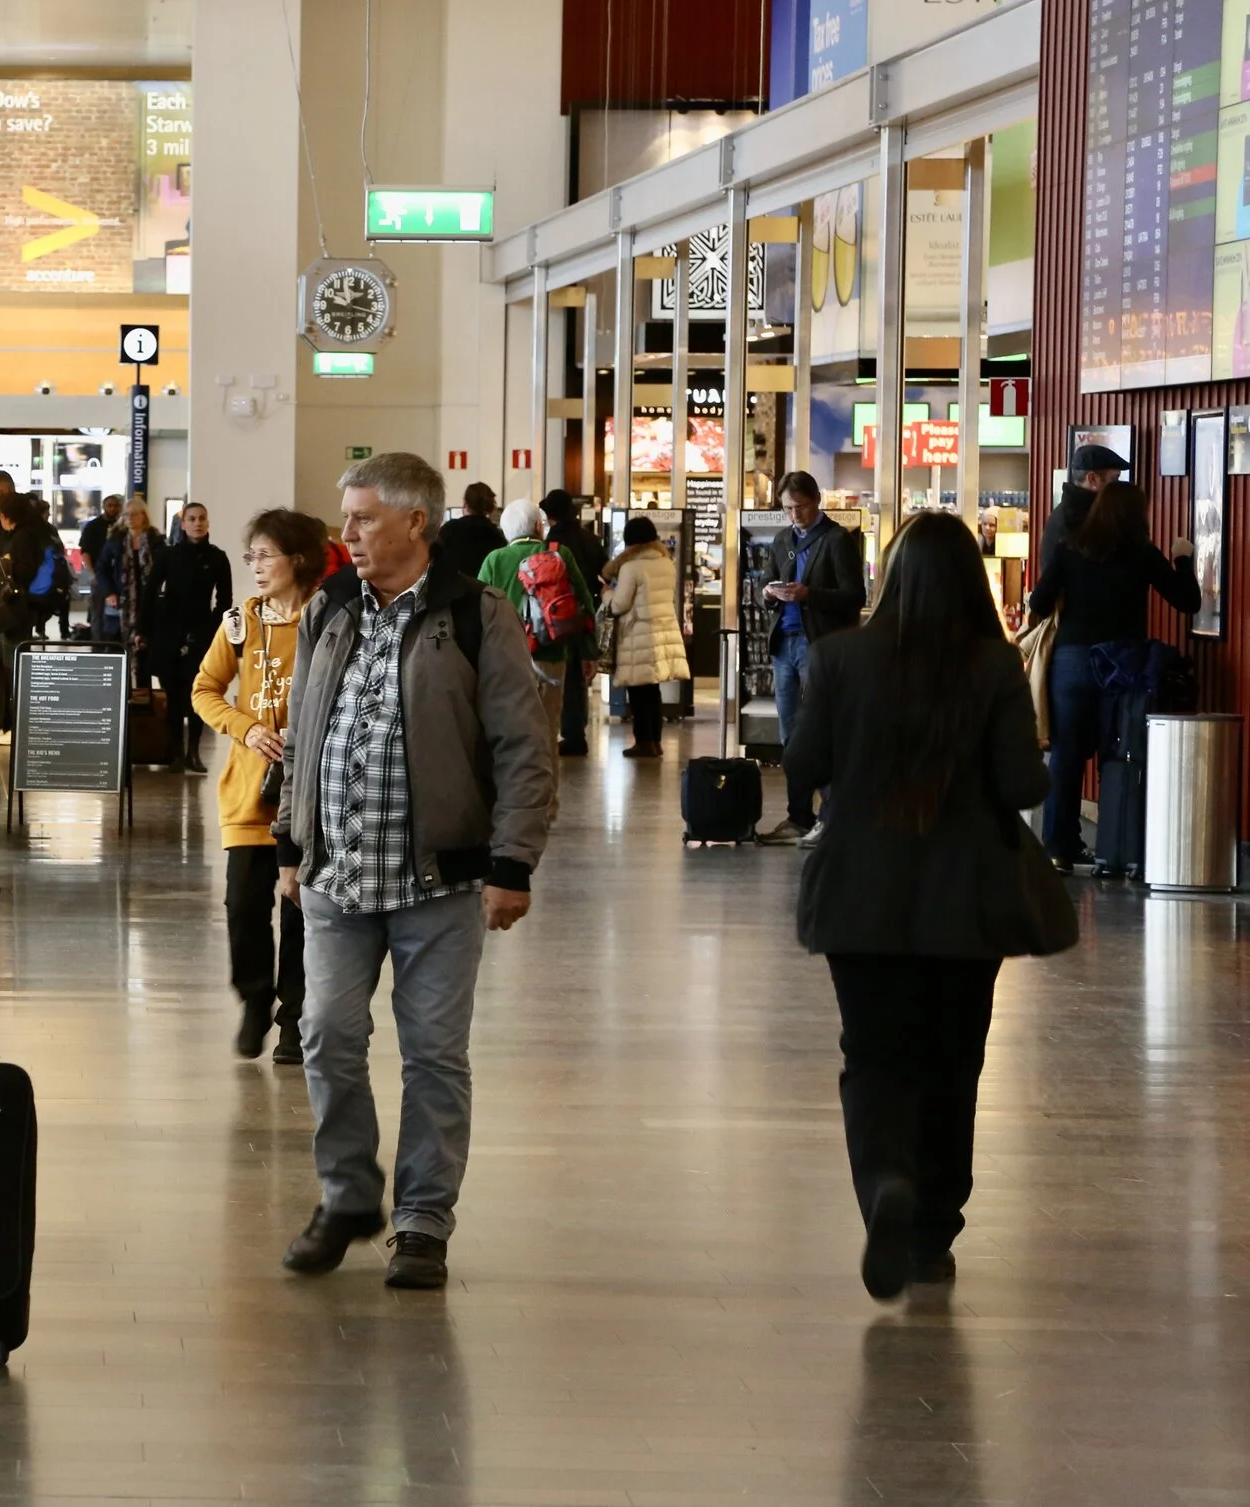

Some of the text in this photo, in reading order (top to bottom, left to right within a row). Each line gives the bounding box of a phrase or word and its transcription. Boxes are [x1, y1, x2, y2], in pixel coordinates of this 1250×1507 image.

[825, 12, 841, 47] free
[147, 92, 186, 110] Each
[6, 114, 53, 132] save?
[146, 139, 158, 156] 3
[641, 406, 723, 416] home body
[133, 412, 147, 484] Information
[928, 437, 955, 450] pay
[922, 450, 959, 464] here
[748, 509, 787, 524] prestige
